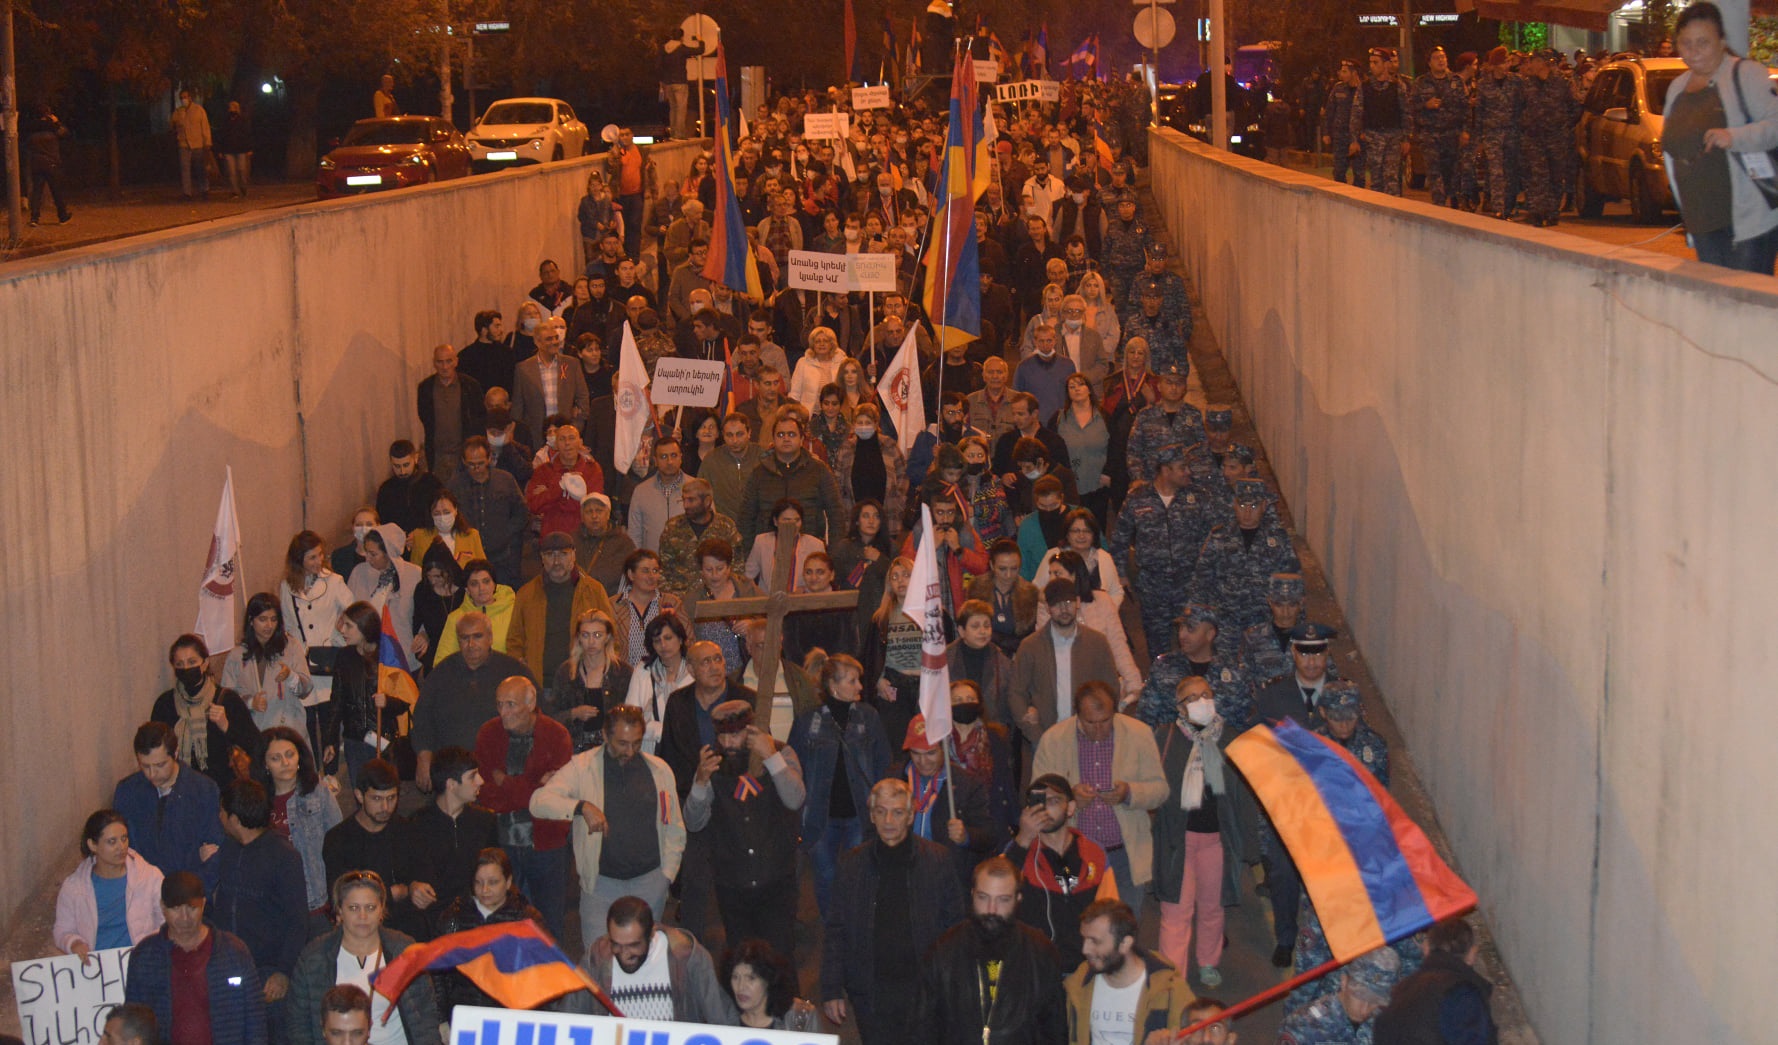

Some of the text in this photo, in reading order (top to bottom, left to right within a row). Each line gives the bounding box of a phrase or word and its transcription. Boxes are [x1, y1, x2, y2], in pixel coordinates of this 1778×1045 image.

[1421, 14, 1459, 22] NEW HIGHWAY
[999, 82, 1039, 100] ԼՈՌԻ
